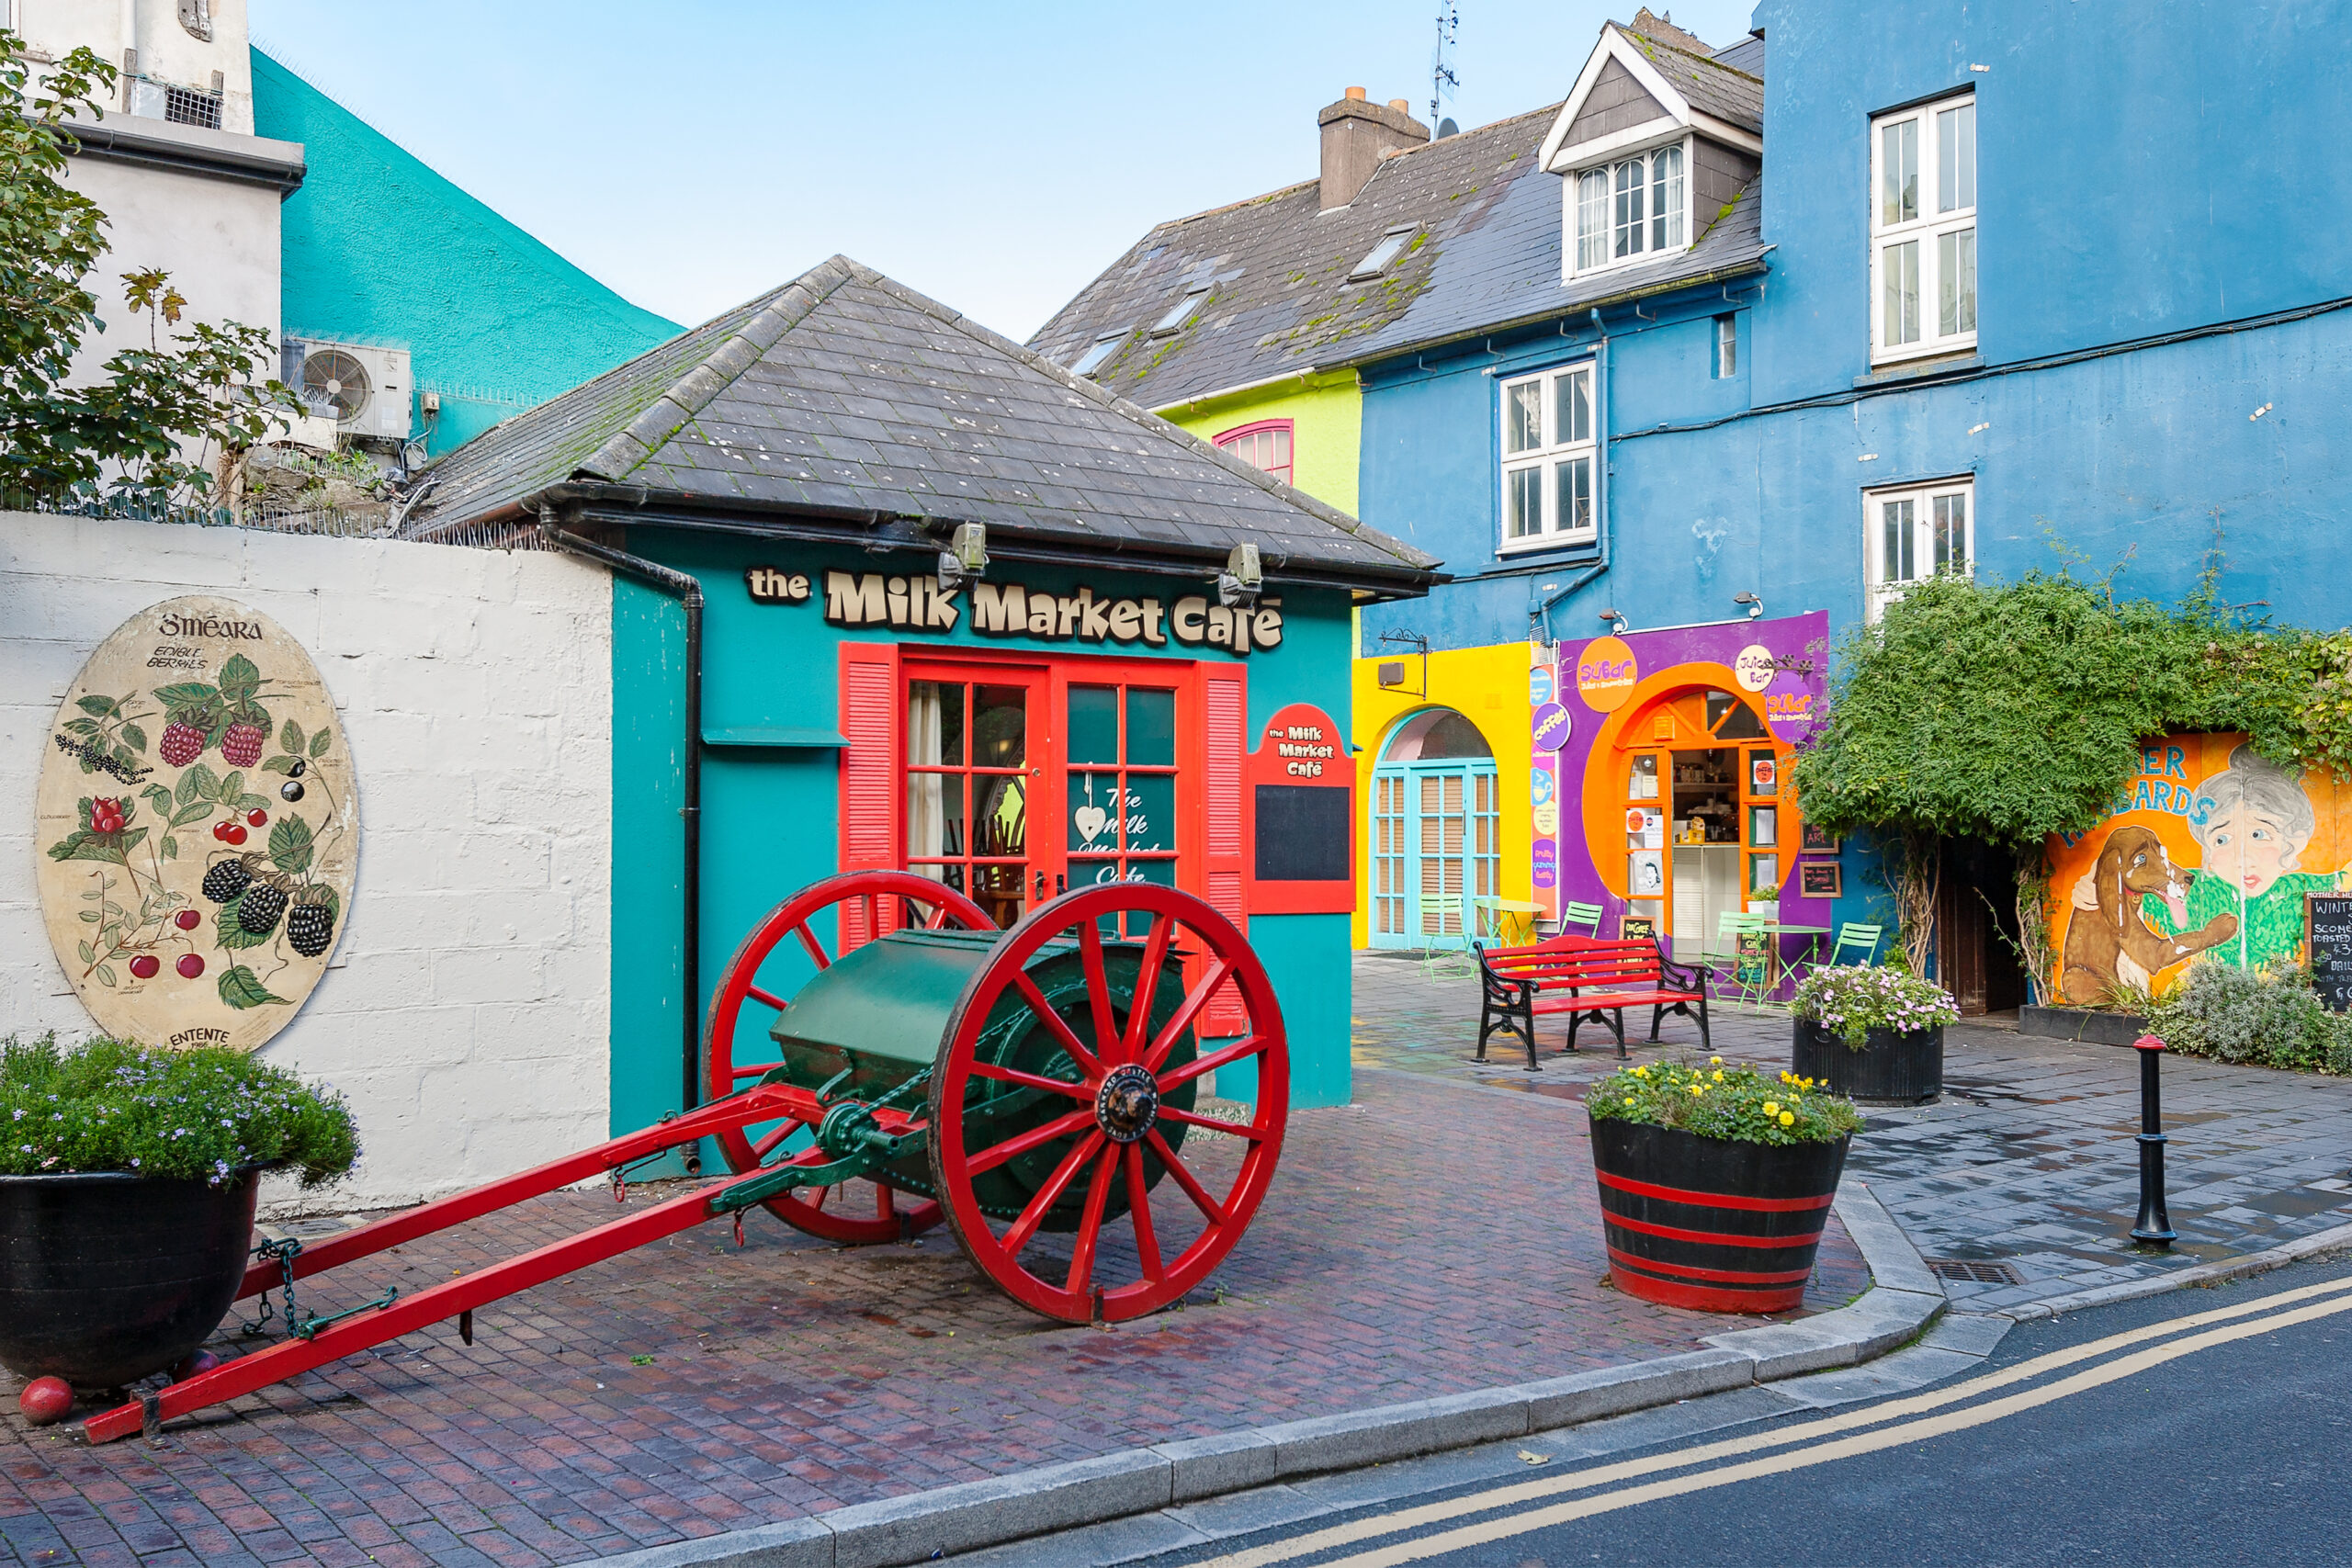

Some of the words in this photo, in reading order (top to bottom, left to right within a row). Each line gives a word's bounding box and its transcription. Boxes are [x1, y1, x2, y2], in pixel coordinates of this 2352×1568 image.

[749, 568, 808, 599] the
[826, 569, 958, 631] Milk
[971, 581, 1167, 643] Market
[153, 646, 204, 658] EDIBLE
[146, 657, 209, 670] BERRIES
[1269, 728, 1283, 739] the
[1287, 726, 1322, 741] Milk
[1278, 743, 1334, 759] Market
[2312, 934, 2351, 943] TOASTED
[169, 1027, 231, 1046] ENTENTE
